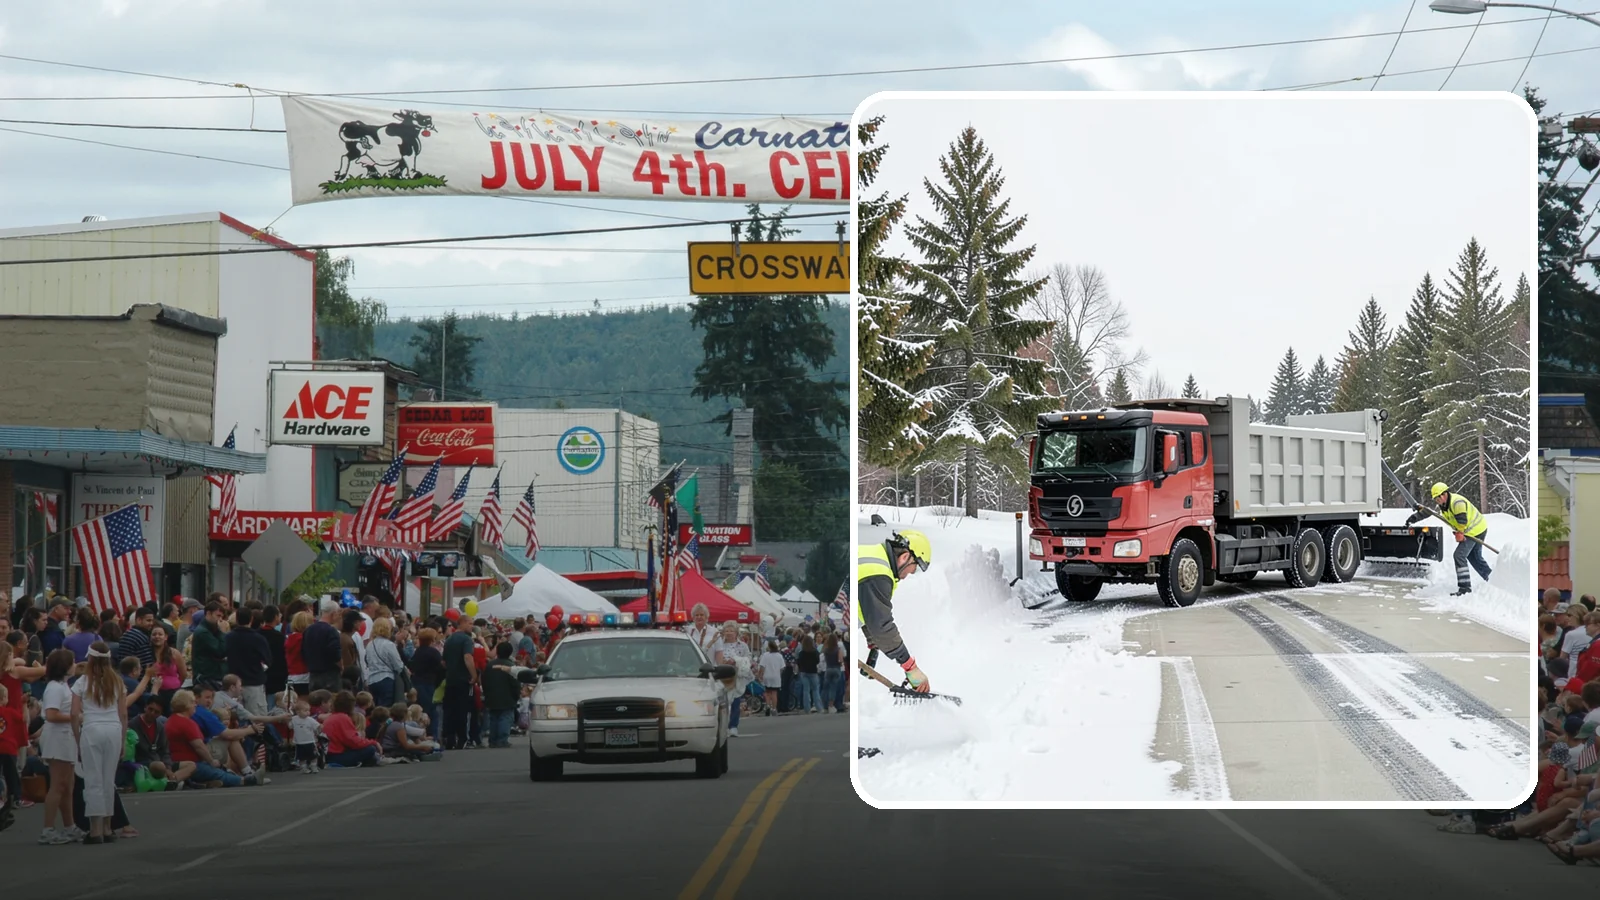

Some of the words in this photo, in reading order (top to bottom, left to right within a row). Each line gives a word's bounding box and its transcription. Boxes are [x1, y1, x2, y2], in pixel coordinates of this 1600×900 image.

[481, 141, 605, 193] JULY
[632, 150, 747, 198] 4th.
[697, 254, 850, 280] CROSSWA
[283, 380, 373, 420] ACE
[405, 409, 452, 422] CEDAR
[283, 421, 371, 436] Hardware
[416, 428, 477, 447] Coca-Cola
[353, 467, 385, 479] Simpl
[96, 485, 124, 494] Vincent
[126, 486, 136, 494] de
[137, 486, 155, 495] Paul
[81, 503, 153, 521] THT
[213, 517, 331, 534] HARDARE
[688, 526, 741, 535] CRNATION
[699, 535, 731, 543] GLASS
